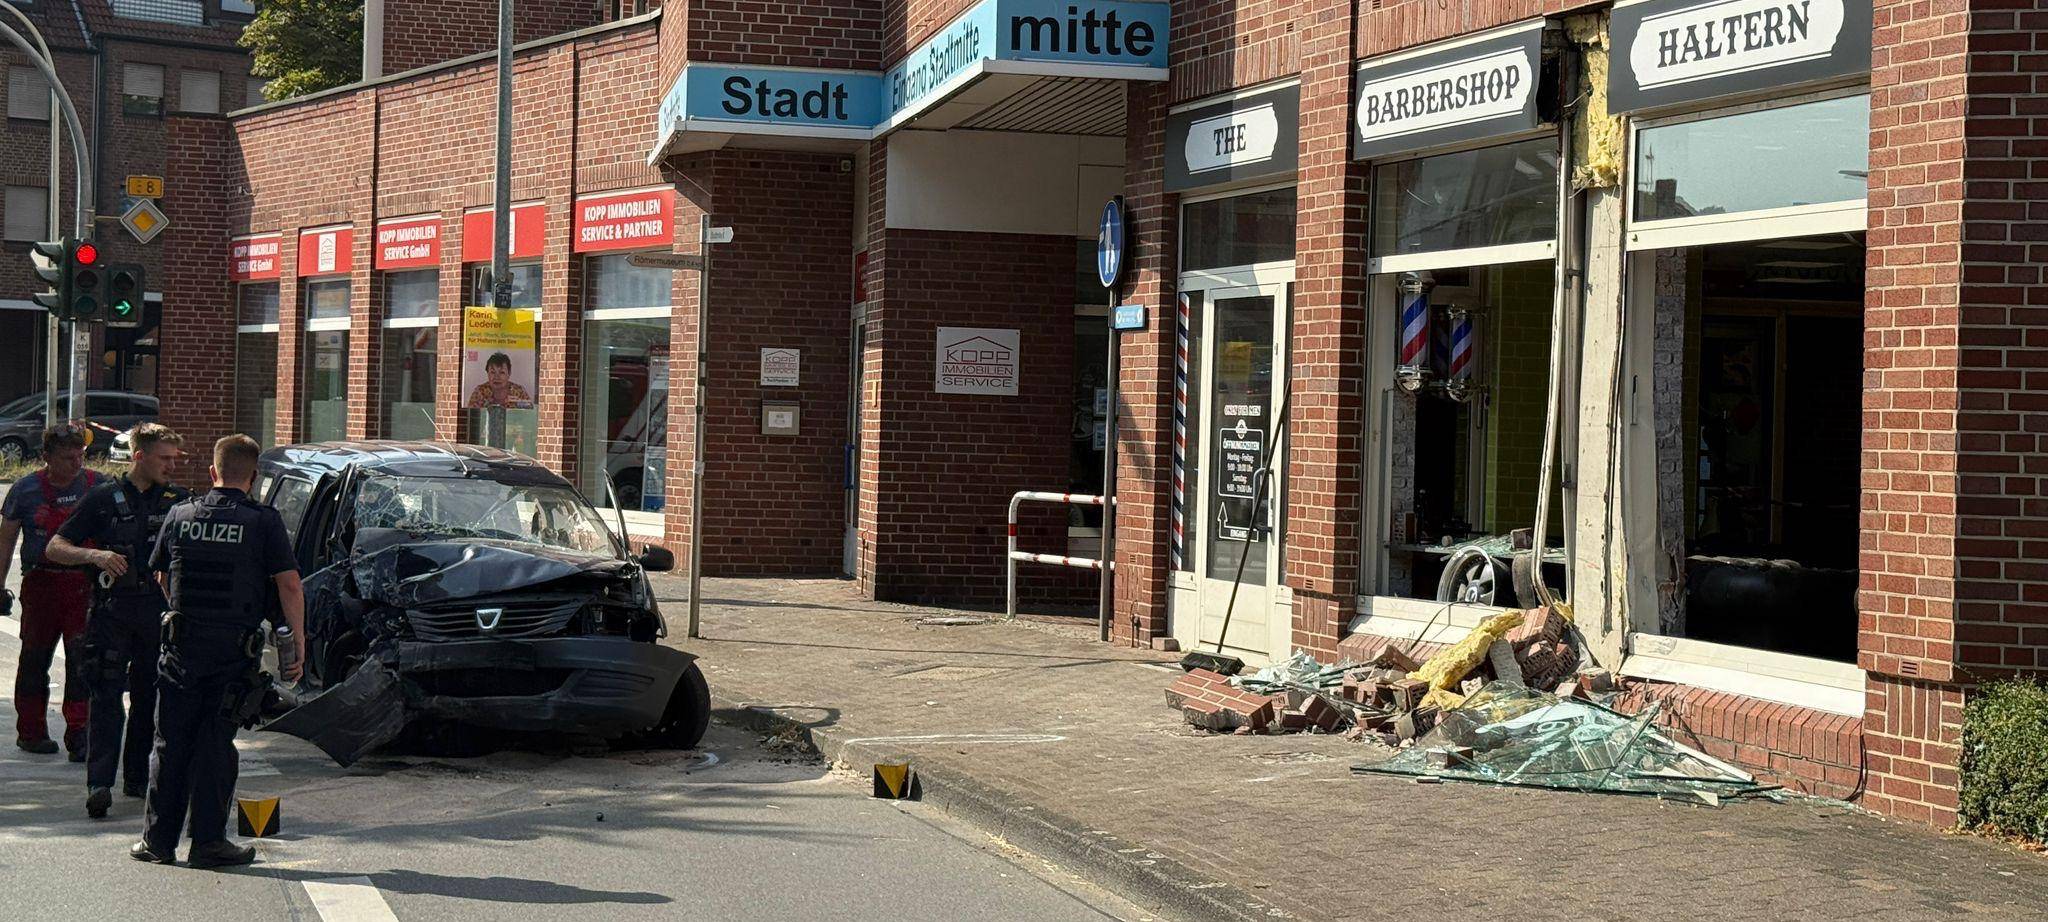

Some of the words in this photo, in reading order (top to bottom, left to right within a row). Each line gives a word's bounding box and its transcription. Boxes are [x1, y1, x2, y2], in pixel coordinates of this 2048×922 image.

[1011, 6, 1155, 57] mitte
[1657, 0, 1811, 69] HALTERN
[892, 63, 928, 113] Eingang
[928, 21, 980, 92] Stadtmitte
[721, 75, 849, 121] Stadt
[1366, 64, 1520, 127] BARBERSHOP
[1213, 123, 1247, 157] THE
[584, 205, 606, 222] KOPP
[607, 198, 661, 220] IMMOBILIEN
[379, 228, 397, 244] KOPP
[397, 225, 437, 242] IMMOBILIEN
[581, 224, 614, 243] SERVICE
[614, 224, 623, 240] &
[624, 219, 663, 239] PARTNER
[383, 245, 410, 261] SERVICE
[410, 243, 431, 258] GmbH
[469, 310, 493, 319] Karin
[469, 319, 503, 329] Lederer
[946, 349, 1011, 363] KOPP
[942, 365, 1013, 376] IMMOBILIEN
[942, 376, 1013, 388] SERVICE
[179, 520, 244, 543] POLIZEI
